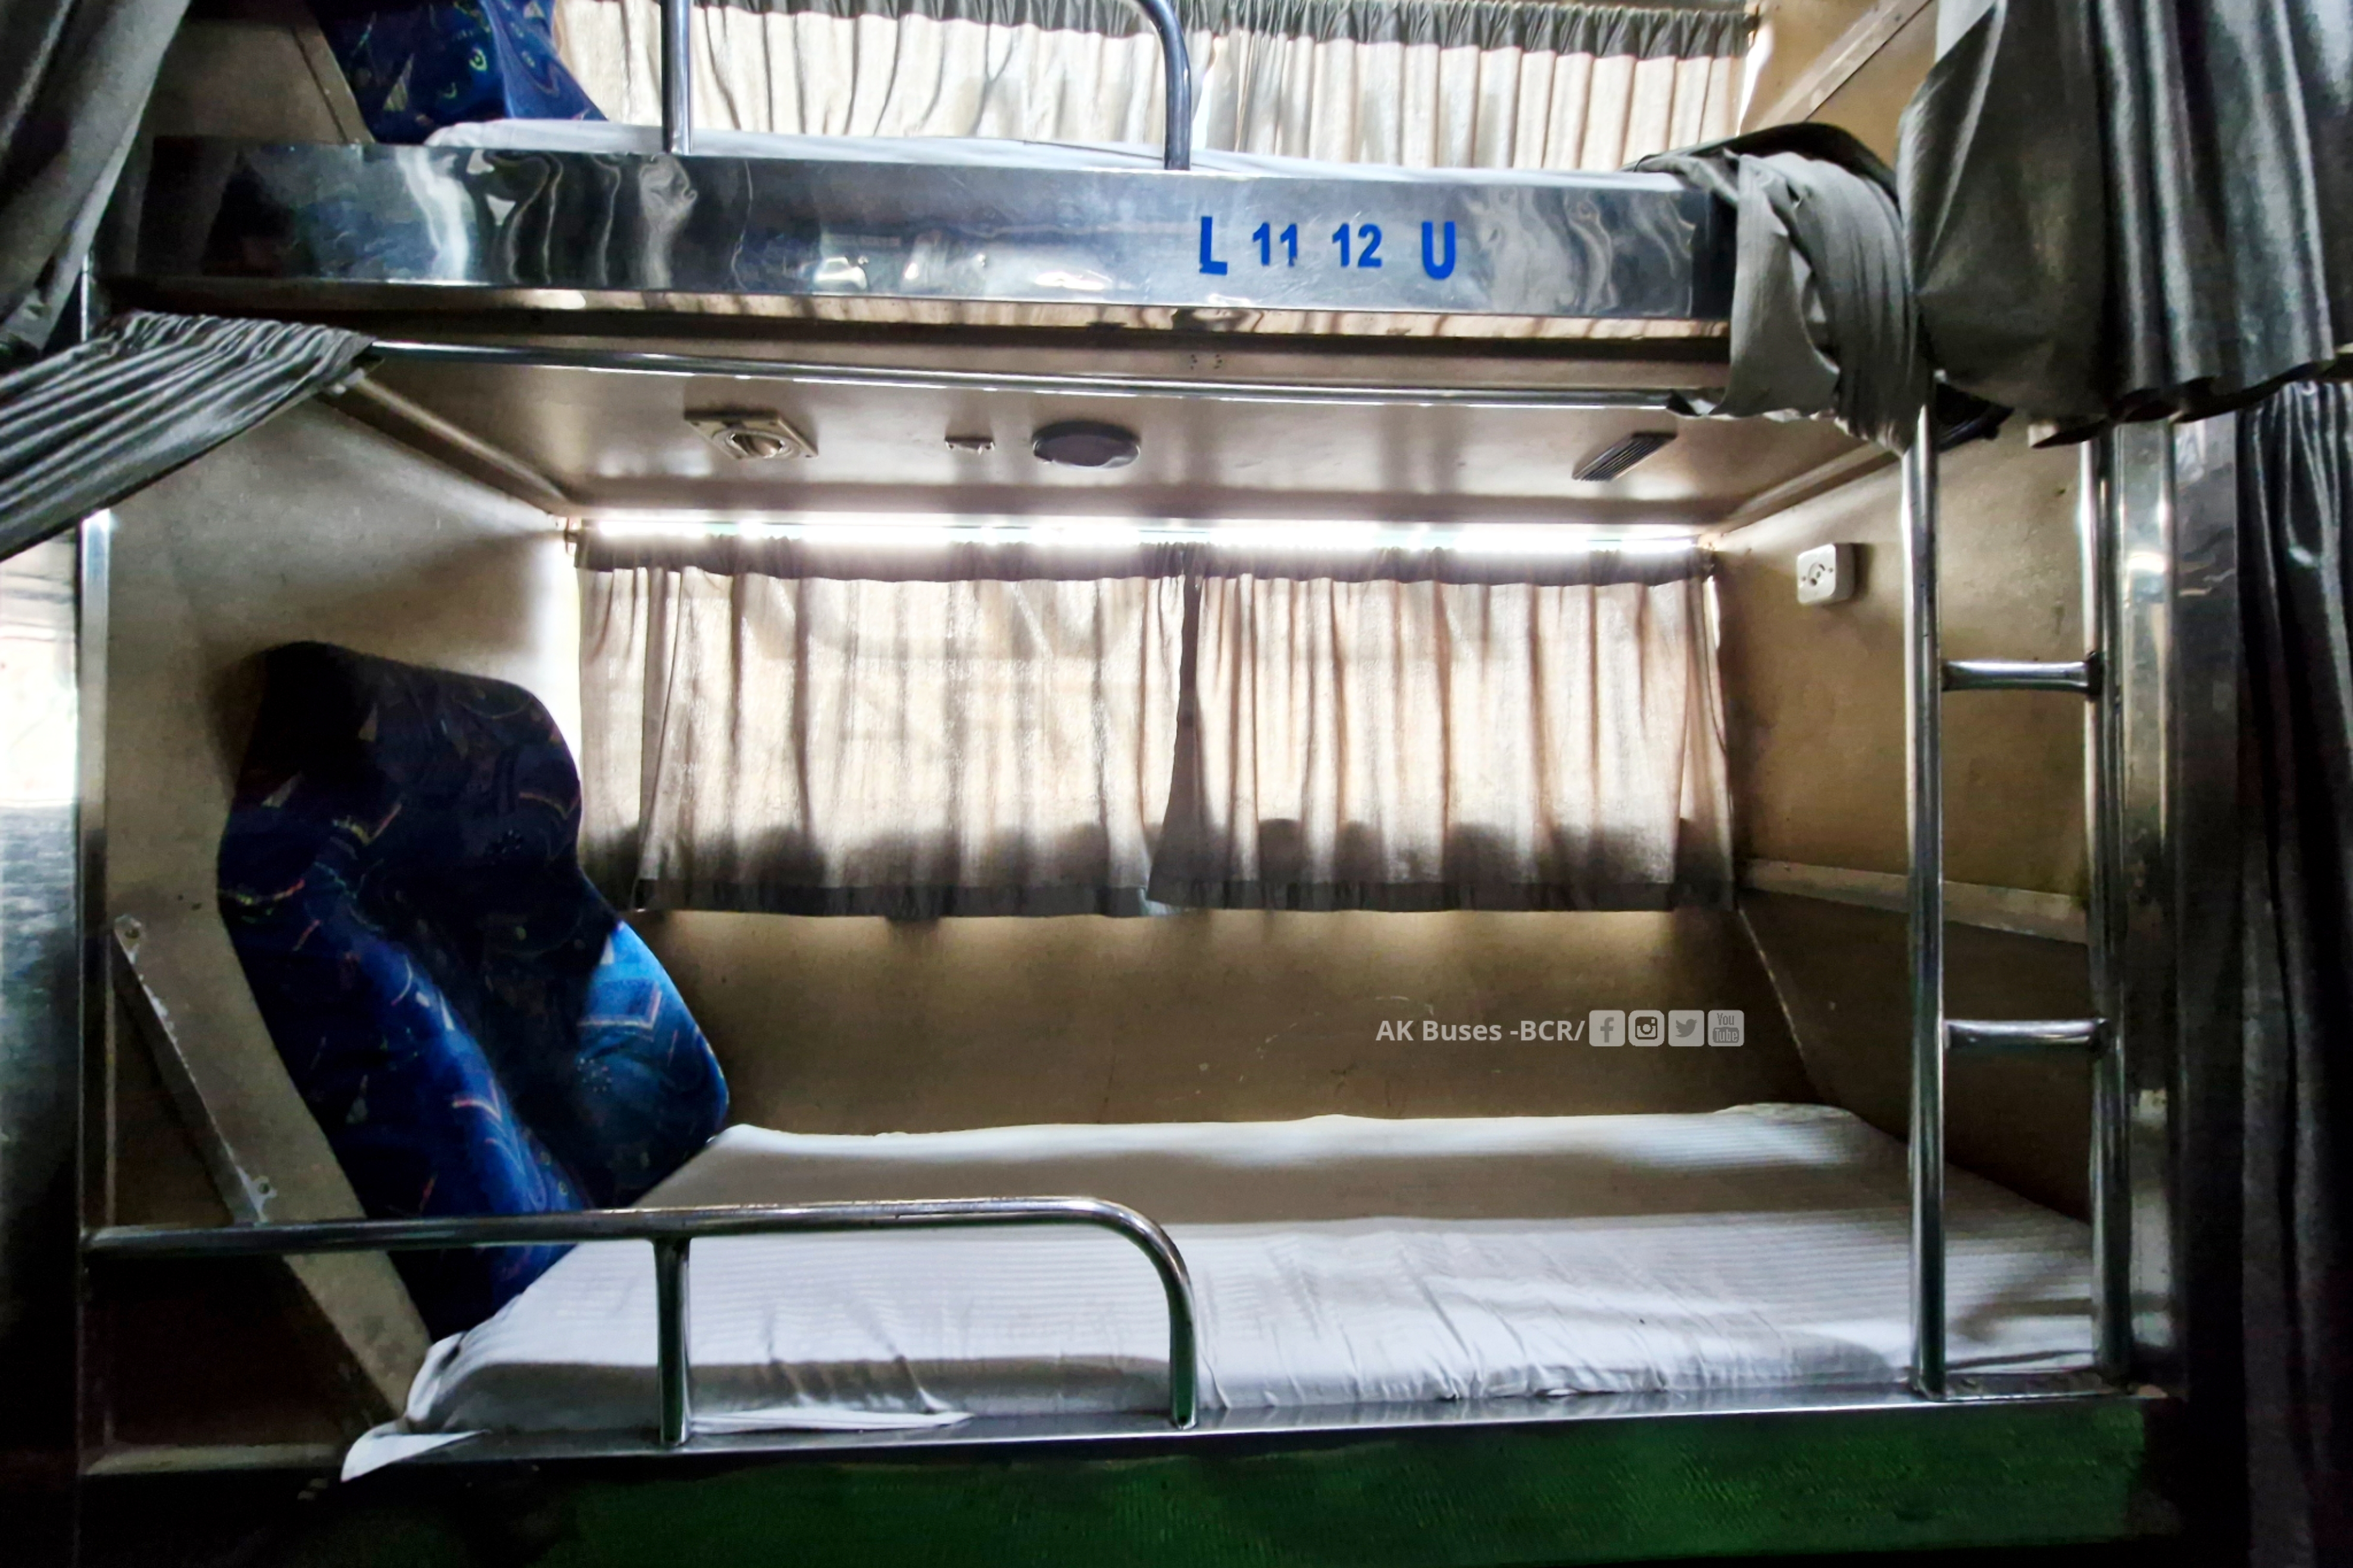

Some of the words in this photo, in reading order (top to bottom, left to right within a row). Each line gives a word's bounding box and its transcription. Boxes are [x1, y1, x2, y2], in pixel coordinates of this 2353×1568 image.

[1199, 215, 1228, 276] L
[1252, 222, 1298, 267] 11
[1332, 223, 1383, 268] 12
[1421, 221, 1457, 281] U
